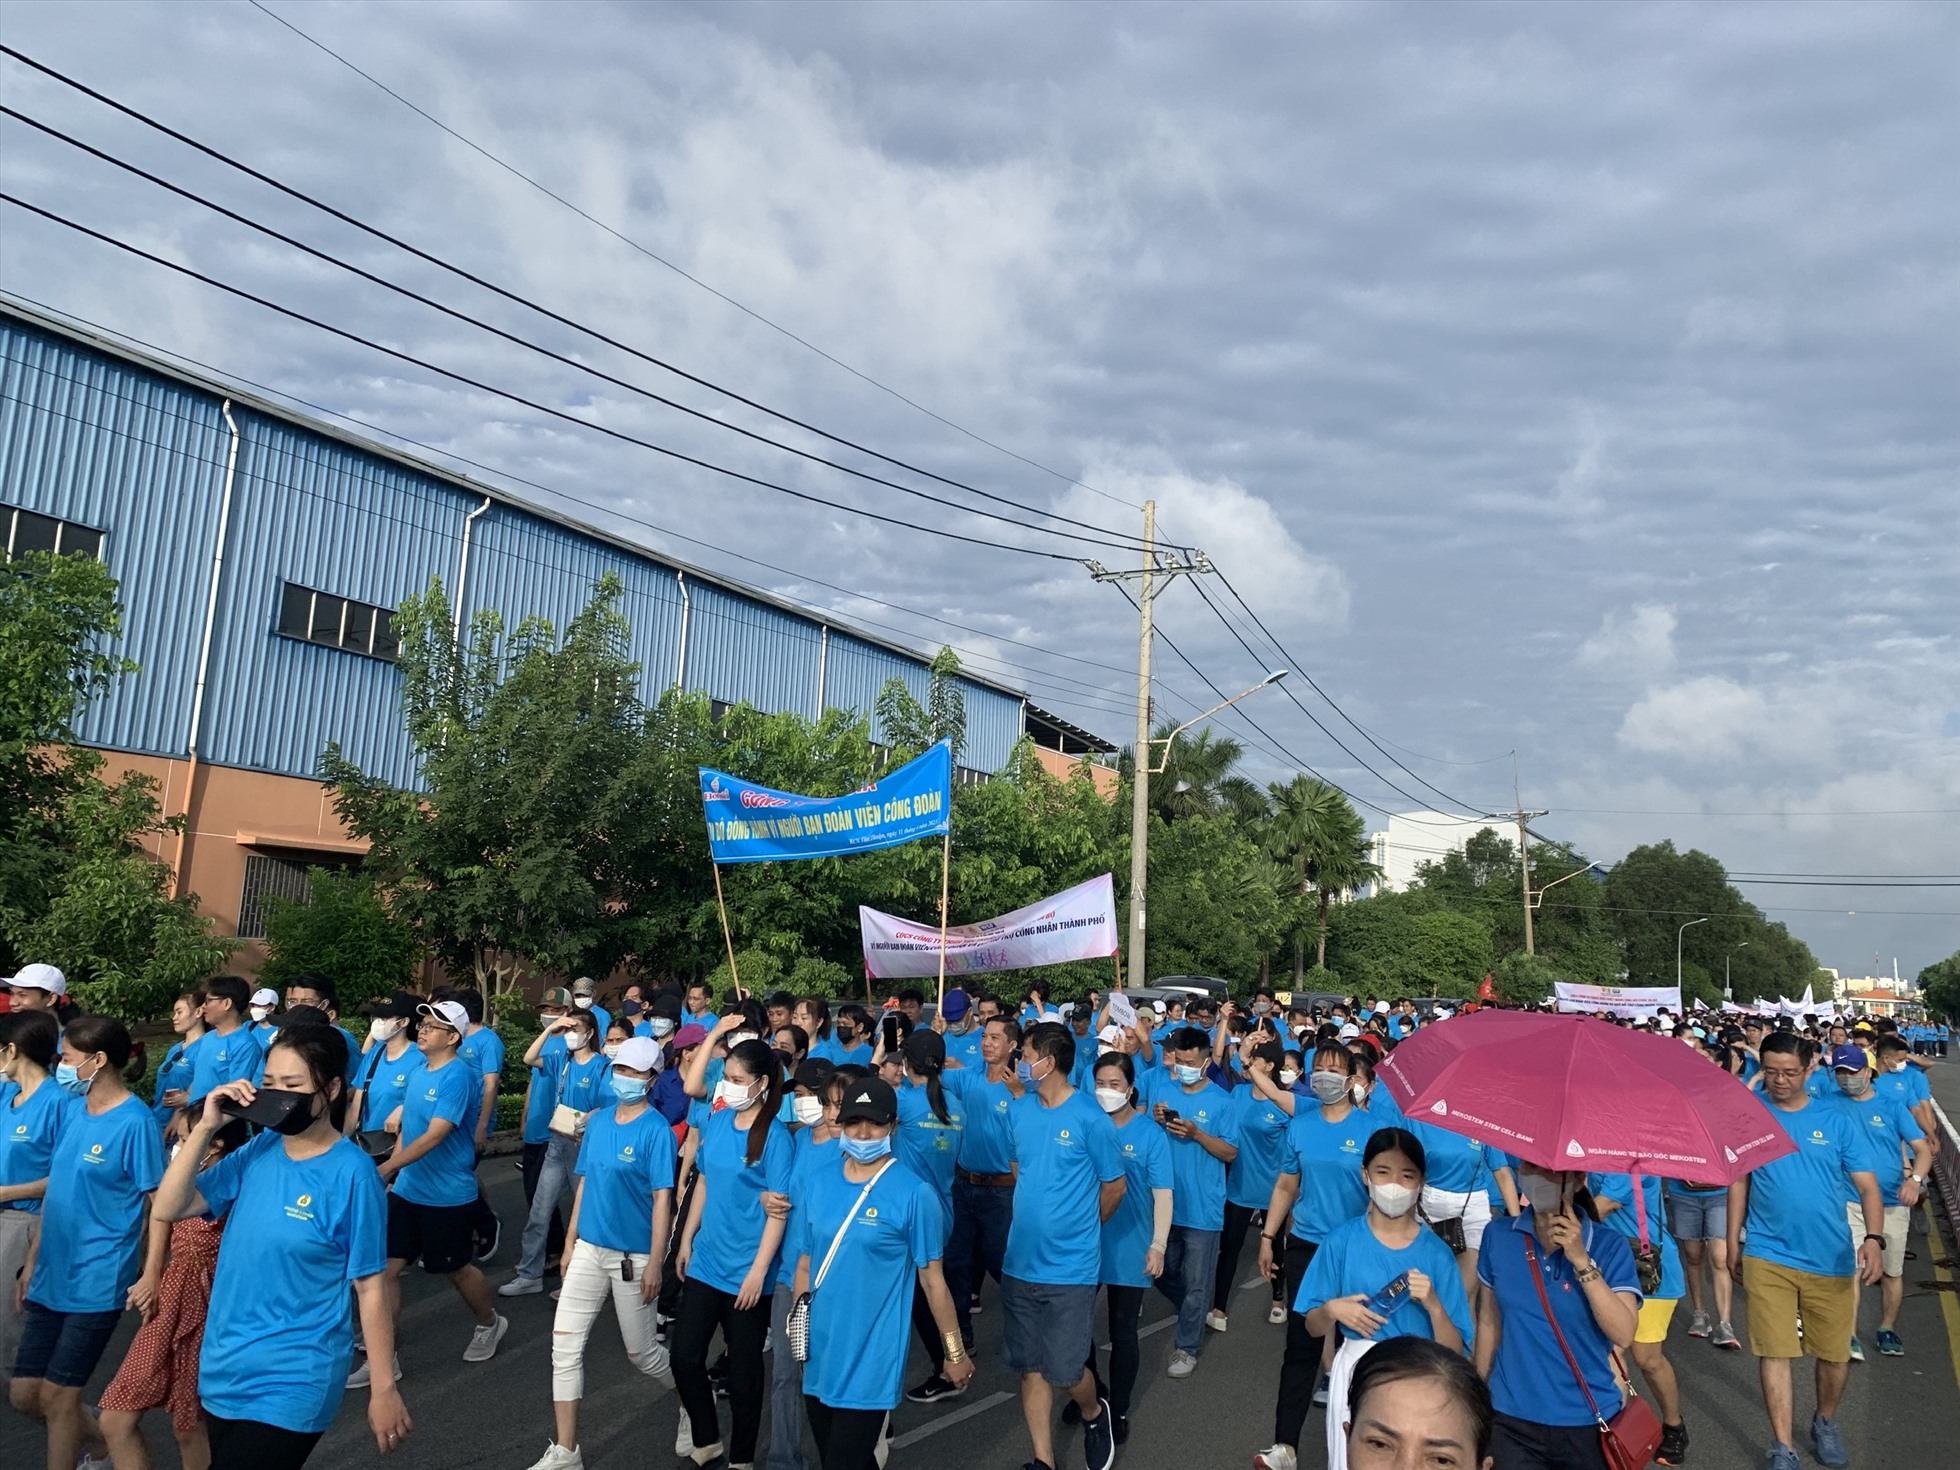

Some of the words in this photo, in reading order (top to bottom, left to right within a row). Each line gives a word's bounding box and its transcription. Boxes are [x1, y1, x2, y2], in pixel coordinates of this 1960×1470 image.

[727, 814, 749, 841] ĐỒNG
[768, 815, 780, 839] VÌ
[777, 813, 804, 838] NGƯỜI
[803, 814, 824, 840] BẠN
[823, 805, 853, 833] ĐOÀN
[854, 801, 881, 828] VIÊN
[884, 797, 912, 823] CÔNG
[914, 788, 942, 817] ĐOÀN
[1015, 926, 1036, 938] CÔNG
[1036, 921, 1058, 934] NHÂN
[1059, 917, 1086, 931] THÀNH
[1088, 911, 1106, 926] PHỐ
[913, 934, 933, 943] CÔNG
[1451, 1109, 1484, 1125] MEKOSTEM
[1483, 1121, 1501, 1132] STEM
[1500, 1127, 1516, 1137] CELL
[1516, 1133, 1535, 1144] BANK
[1588, 1147, 1608, 1155] NGÂN
[1608, 1149, 1627, 1157] HÀNG
[1638, 1151, 1653, 1159] BÀO
[1653, 1152, 1669, 1160] GỐC
[1669, 1154, 1707, 1164] MEKOSTEM
